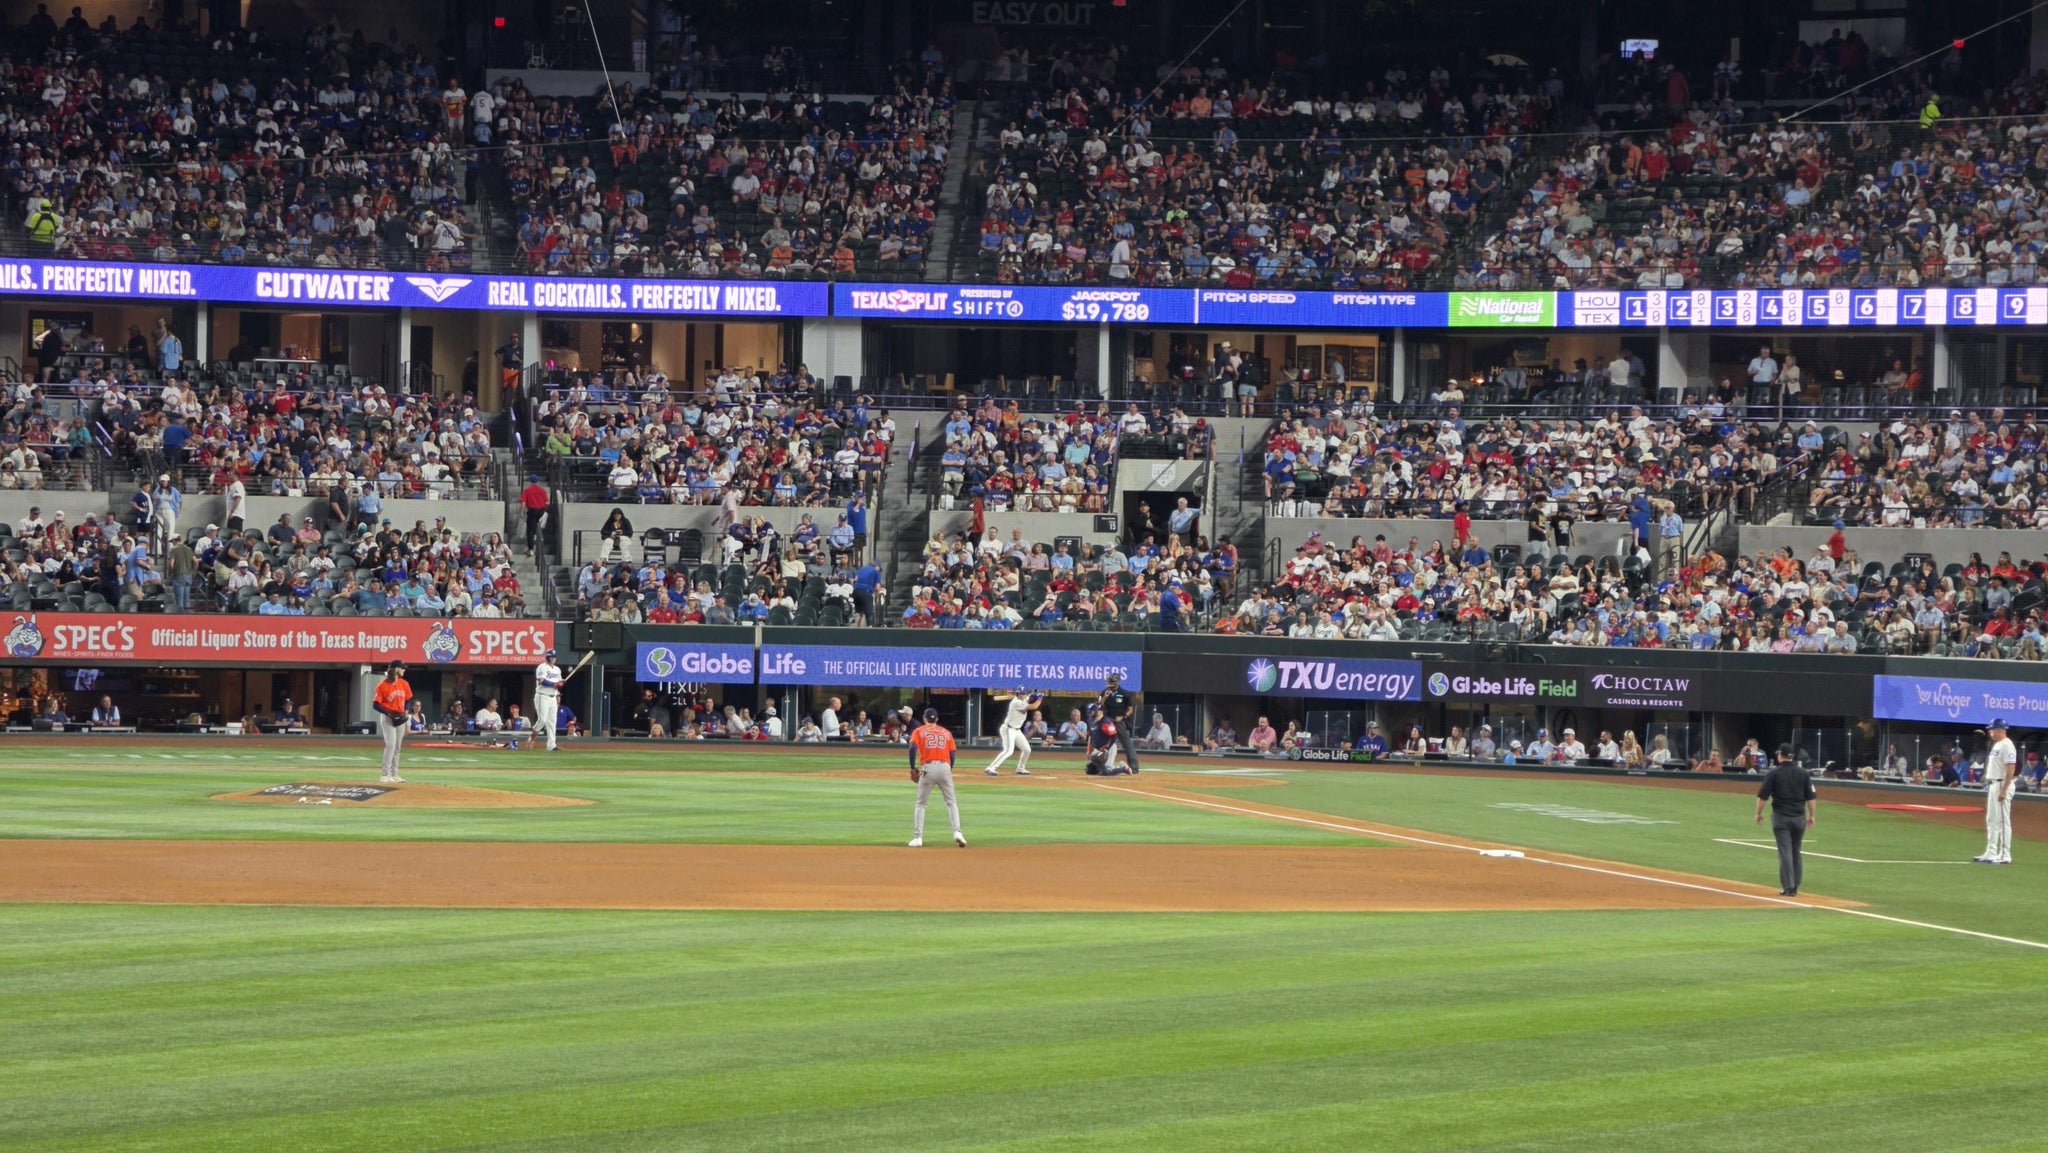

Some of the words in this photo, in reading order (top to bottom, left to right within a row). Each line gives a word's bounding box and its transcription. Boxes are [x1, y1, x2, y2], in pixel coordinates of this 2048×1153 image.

[972, 1, 1037, 24] EASY
[1044, 2, 1096, 25] OUT
[43, 265, 134, 294] PERFECTLY
[139, 269, 197, 296] MIXED.
[256, 272, 394, 301] CUTWATER
[488, 281, 529, 307] REAL
[534, 282, 628, 309] COCKTAILS.
[632, 284, 720, 311] PERFECTLY
[725, 286, 781, 312] MIXED.
[960, 289, 1002, 298] PRESENTED
[1003, 290, 1013, 299] BY
[1071, 291, 1142, 302] JACKPOT
[1203, 292, 1247, 303] PITCH
[1249, 293, 1297, 304] SPEED
[1333, 294, 1377, 305] PITCH
[1379, 295, 1416, 306] TYPE
[1580, 296, 1617, 307] HOU
[1652, 293, 1661, 306] 3
[1697, 293, 1706, 306] 0
[1743, 292, 1752, 306] 2
[1788, 292, 1797, 305] 0
[1835, 291, 1844, 305] 0
[1062, 301, 1150, 323] $19,780
[1478, 297, 1543, 315] National
[1632, 300, 1644, 317] 1
[1676, 300, 1689, 316] 2
[1721, 300, 1734, 316] 3
[1766, 299, 1779, 316] 4
[1813, 299, 1826, 316] 5
[1860, 299, 1874, 315] 6
[1910, 299, 1923, 315] 7
[1959, 298, 1973, 315] 8
[2010, 297, 2024, 314] 9
[1581, 313, 1615, 324] TEX
[1652, 310, 1661, 323] 0
[1697, 310, 1705, 323] 1
[1742, 310, 1751, 323] 0
[1788, 310, 1797, 323] 0
[1910, 557, 1921, 568] 13
[53, 620, 135, 651] SPEC'S
[151, 629, 198, 647] Official
[201, 630, 240, 651] Liquor
[243, 630, 277, 648] Store
[280, 630, 294, 648] of
[296, 631, 317, 648] the
[320, 631, 354, 649] Texas
[358, 632, 407, 653] Rangers
[469, 625, 546, 655] SPEC'S
[681, 652, 752, 675] Globe
[763, 652, 807, 675] Life
[823, 660, 843, 675] THE
[846, 661, 892, 676] OFFICIAL
[896, 662, 918, 677] LIFE
[920, 662, 979, 678] INSURANCE
[982, 664, 995, 678] OF
[998, 664, 1021, 679] THE
[1026, 665, 1064, 680] TEXAS
[1278, 661, 1336, 689] TXU
[1335, 673, 1415, 700] energy
[1504, 677, 1536, 696] Life
[1538, 679, 1577, 698] Field
[1601, 674, 1690, 692] CHOCTAW
[1607, 698, 1640, 706] CASINOS
[1649, 699, 1684, 707] RESORTS
[1933, 682, 1972, 718] Kroger
[1983, 694, 2015, 710] Texas
[926, 733, 947, 749] 28
[1303, 749, 1331, 760] Globe
[1331, 750, 1350, 761] Life
[1350, 751, 1372, 762] Field
